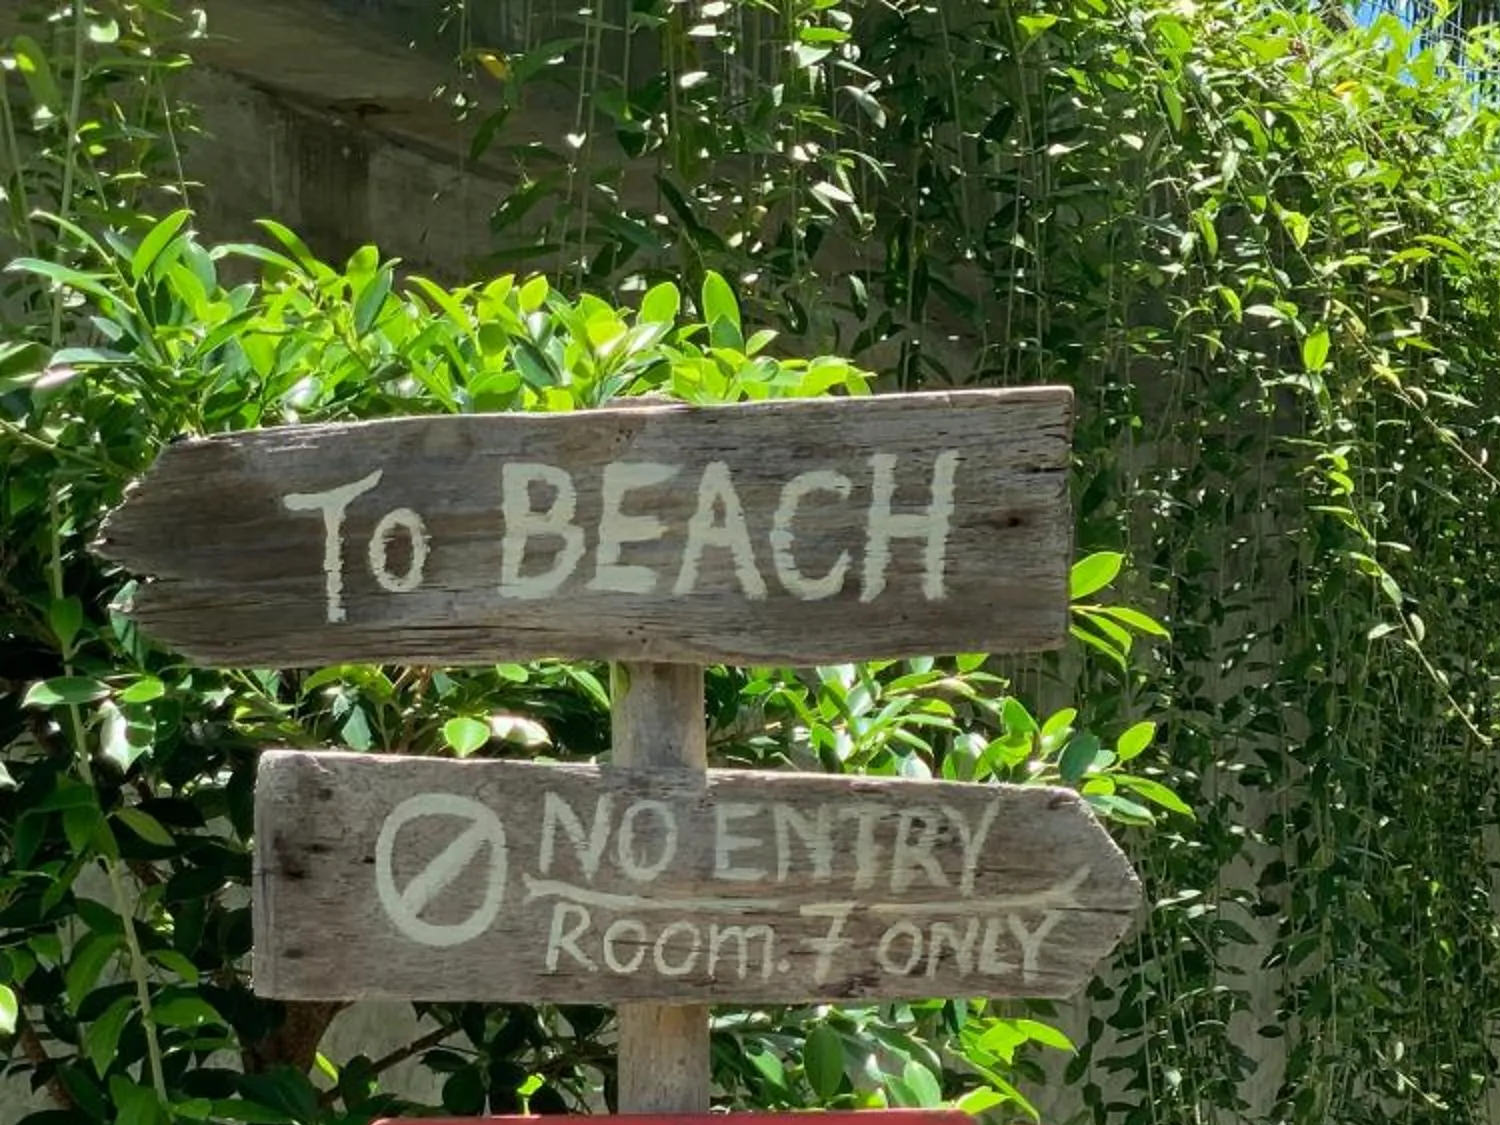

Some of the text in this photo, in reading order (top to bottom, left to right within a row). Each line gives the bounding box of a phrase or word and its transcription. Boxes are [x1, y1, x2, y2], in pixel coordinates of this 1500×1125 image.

[499, 449, 960, 604] BEACH
[538, 789, 1001, 899] NO ENTRY
[878, 907, 1064, 982] ONLY
